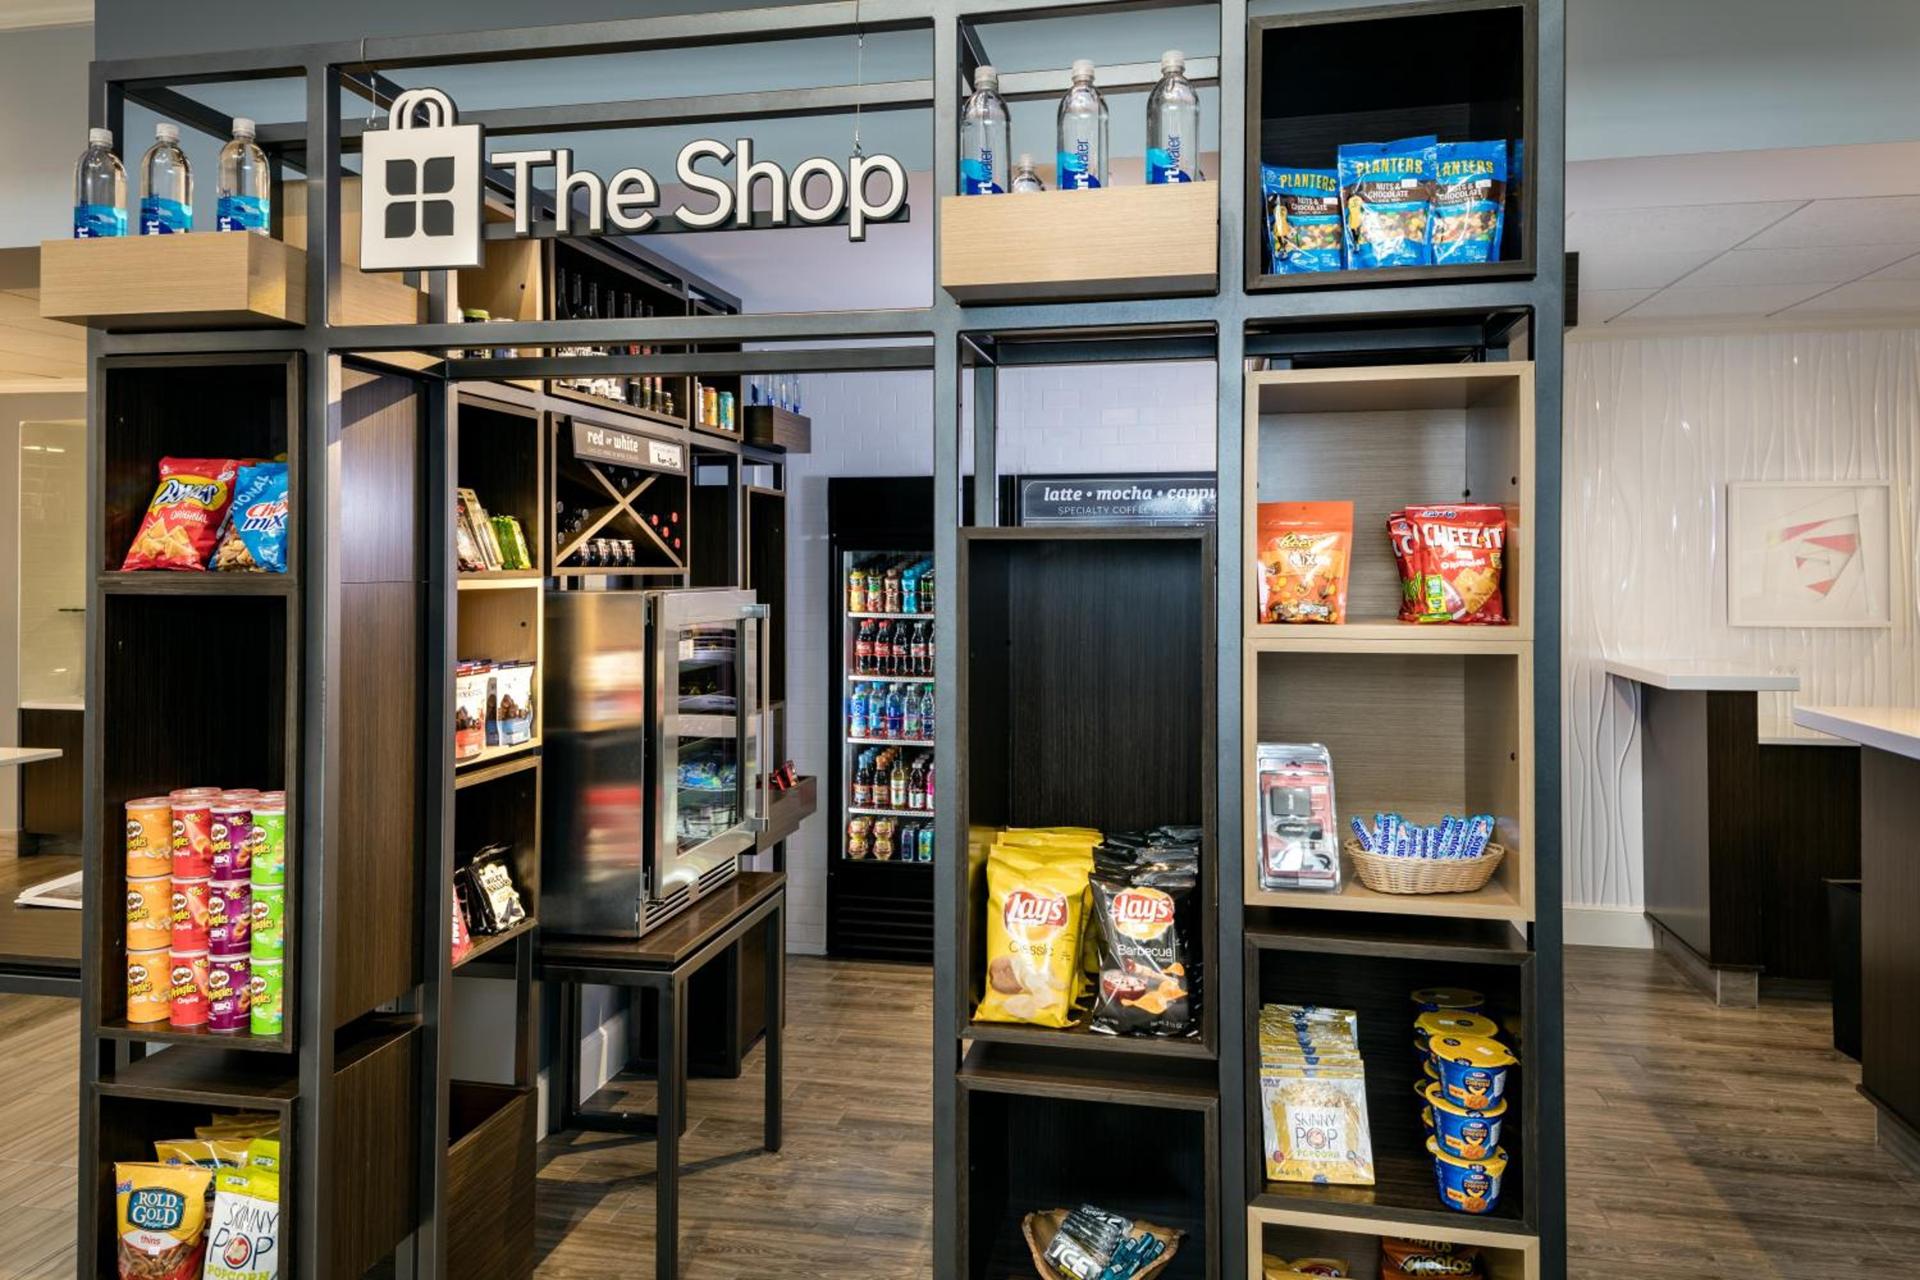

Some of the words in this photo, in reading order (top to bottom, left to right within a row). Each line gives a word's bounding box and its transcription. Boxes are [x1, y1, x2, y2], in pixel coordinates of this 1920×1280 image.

[1355, 156, 1423, 177] PLANTERS
[1436, 161, 1494, 177] LANTERS
[491, 148, 661, 233] The
[673, 137, 908, 242] Shop
[1280, 173, 1337, 192] PLANTERS
[587, 430, 604, 446] red
[613, 435, 639, 453] white
[1043, 486, 1082, 502] latte
[1096, 486, 1153, 501] mocha
[1167, 487, 1217, 504] cappu
[1057, 505, 1110, 516] SPECIALTY
[1008, 896, 1065, 926] Lay's
[1117, 896, 1171, 925] Lay's
[1117, 944, 1174, 958] Barbecue
[212, 1001, 233, 1013] BBQ
[1294, 1112, 1337, 1128] SKINNY
[1295, 1126, 1338, 1150] POP
[139, 1191, 177, 1208] ROLD
[132, 1205, 178, 1226] GOLD
[223, 1200, 279, 1235] SKINNY
[140, 1235, 162, 1247] thins
[208, 1226, 275, 1271] POP
